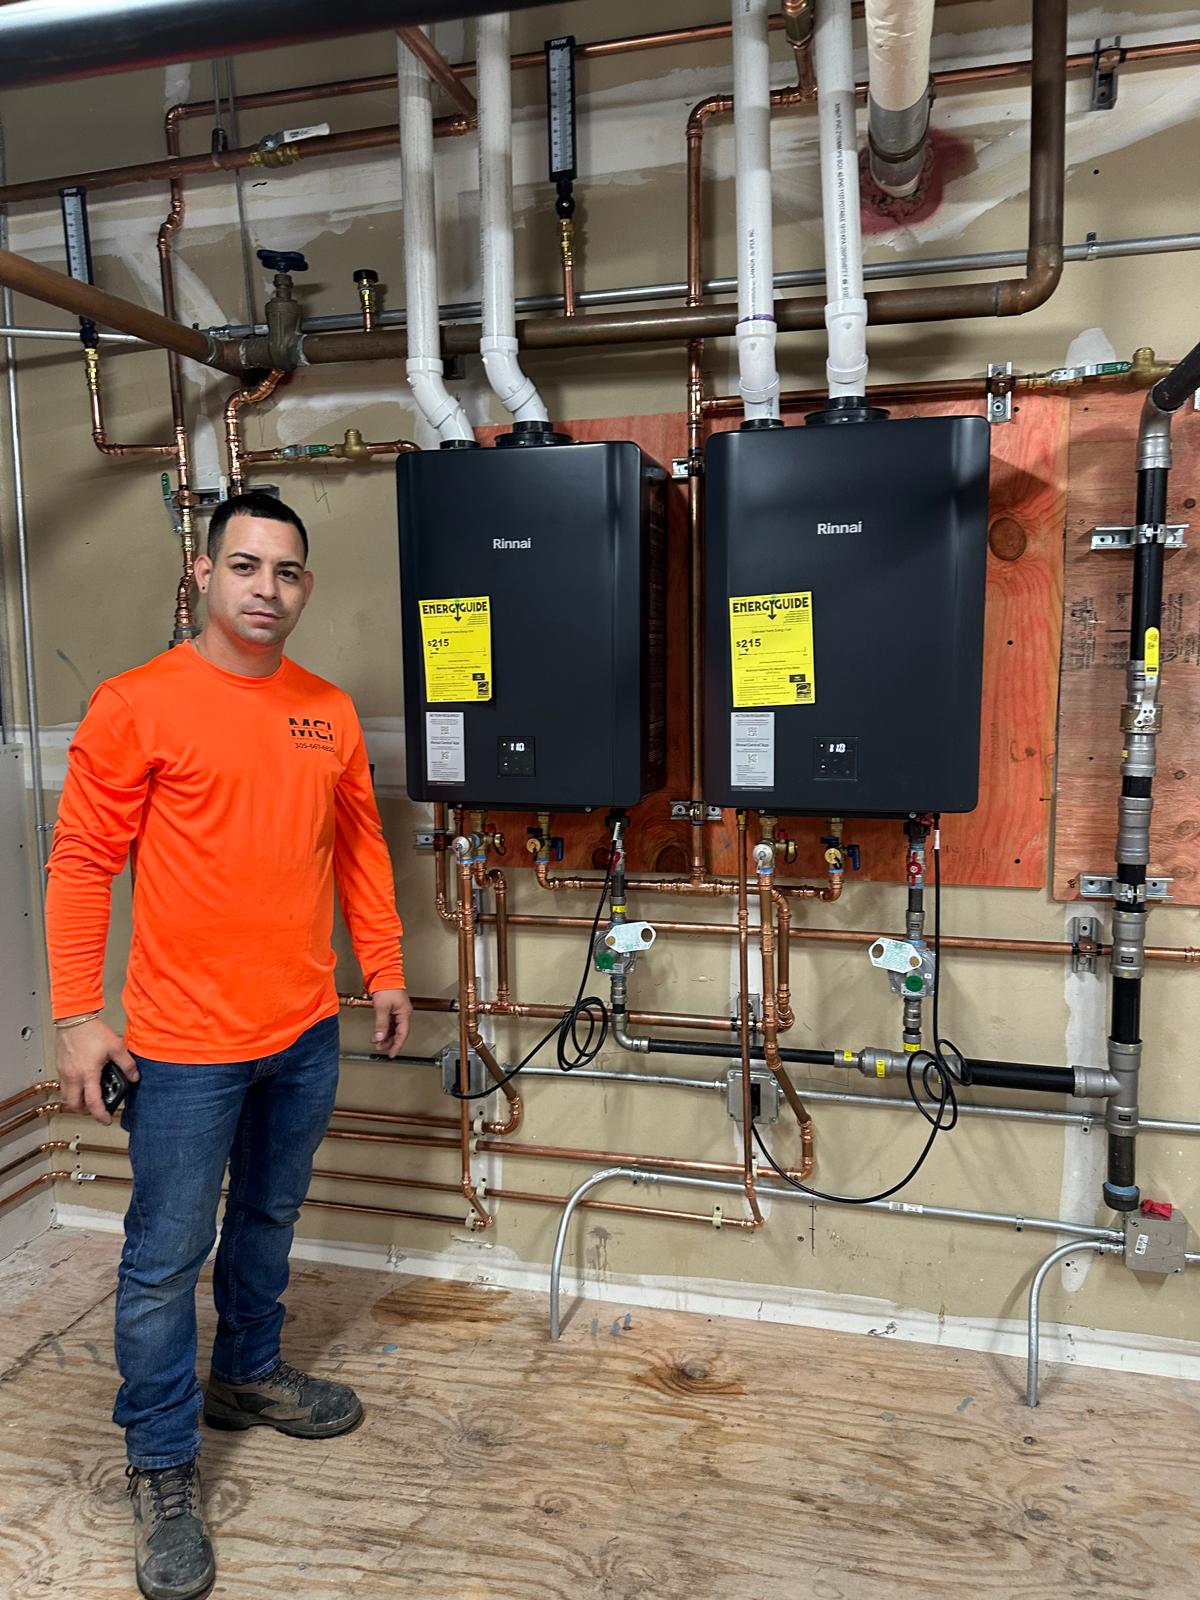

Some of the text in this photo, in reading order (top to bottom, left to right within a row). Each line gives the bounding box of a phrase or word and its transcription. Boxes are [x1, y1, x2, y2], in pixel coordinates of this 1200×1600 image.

[817, 520, 863, 535] Rinnai
[492, 537, 532, 550] Rinnai
[428, 638, 450, 648] $215
[736, 638, 761, 648] $215
[288, 718, 334, 742] MCI
